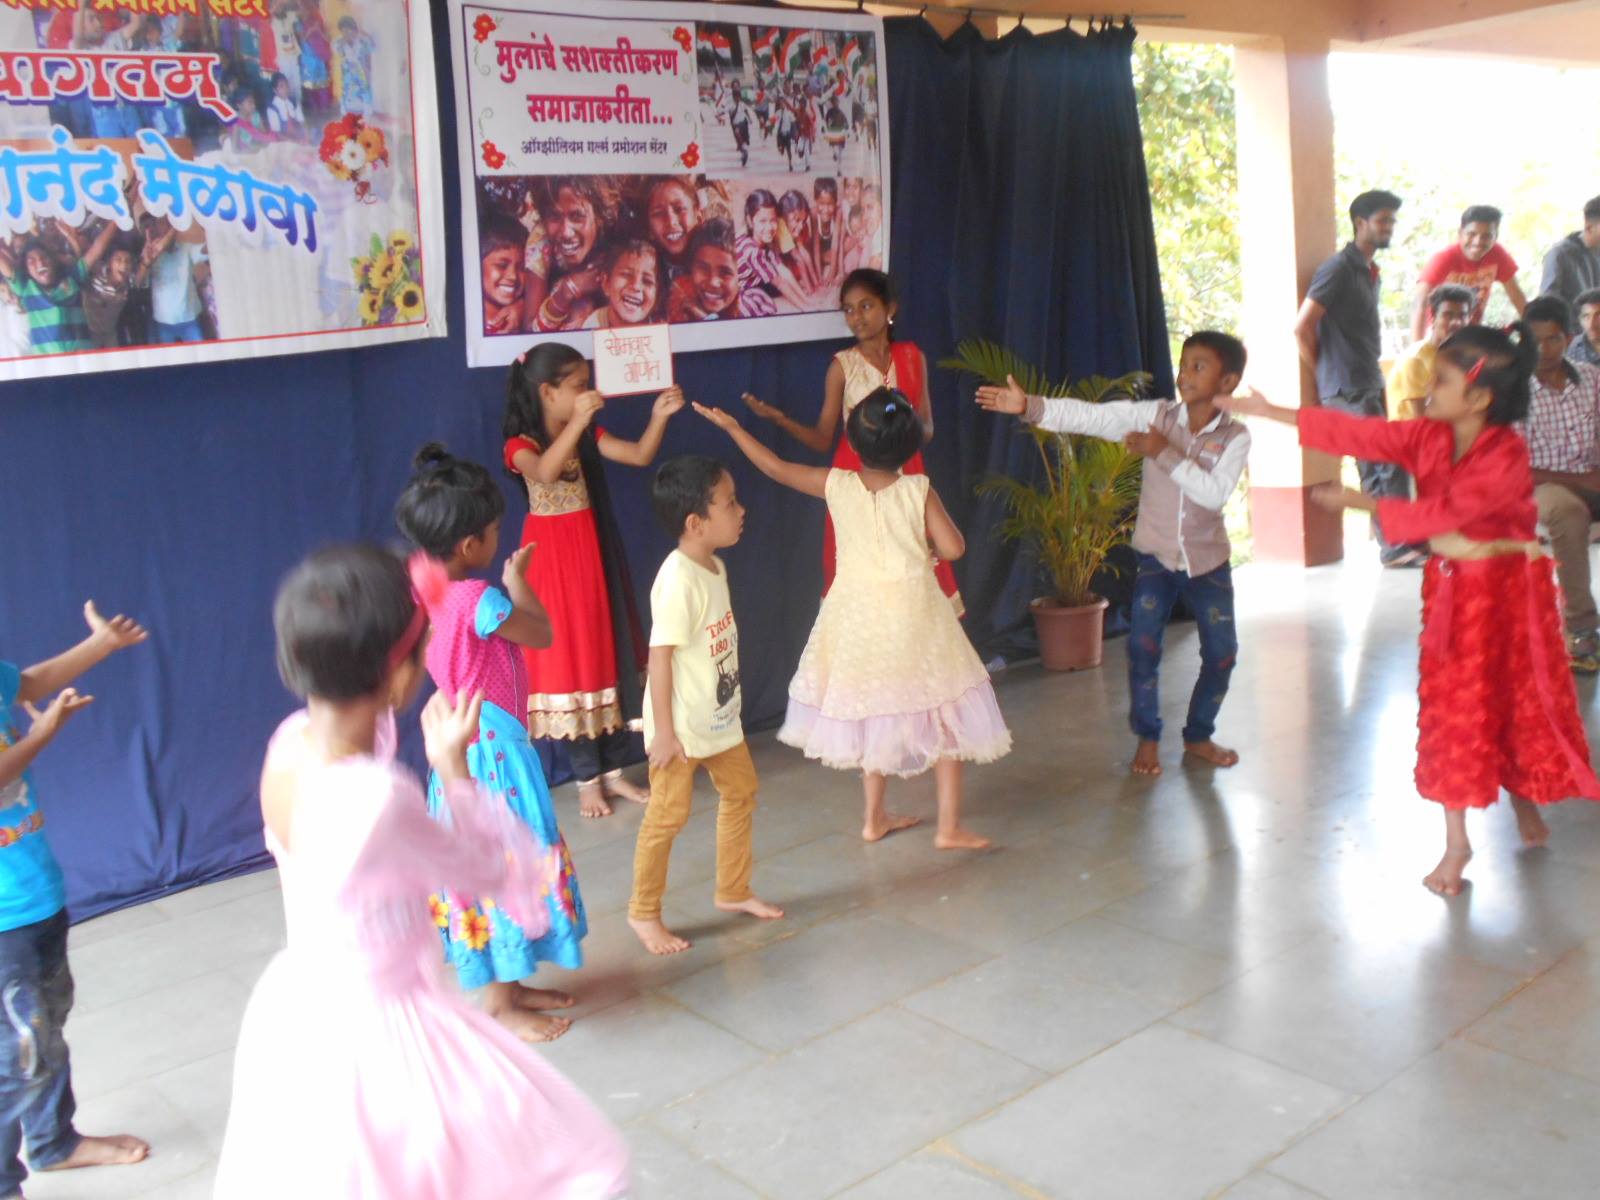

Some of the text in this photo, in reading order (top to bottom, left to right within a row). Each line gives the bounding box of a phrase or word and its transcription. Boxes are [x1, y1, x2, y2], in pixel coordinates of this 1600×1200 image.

[495, 32, 678, 83] मुलांचे सशक्तीकरण
[136, 131, 319, 253] मेळावा
